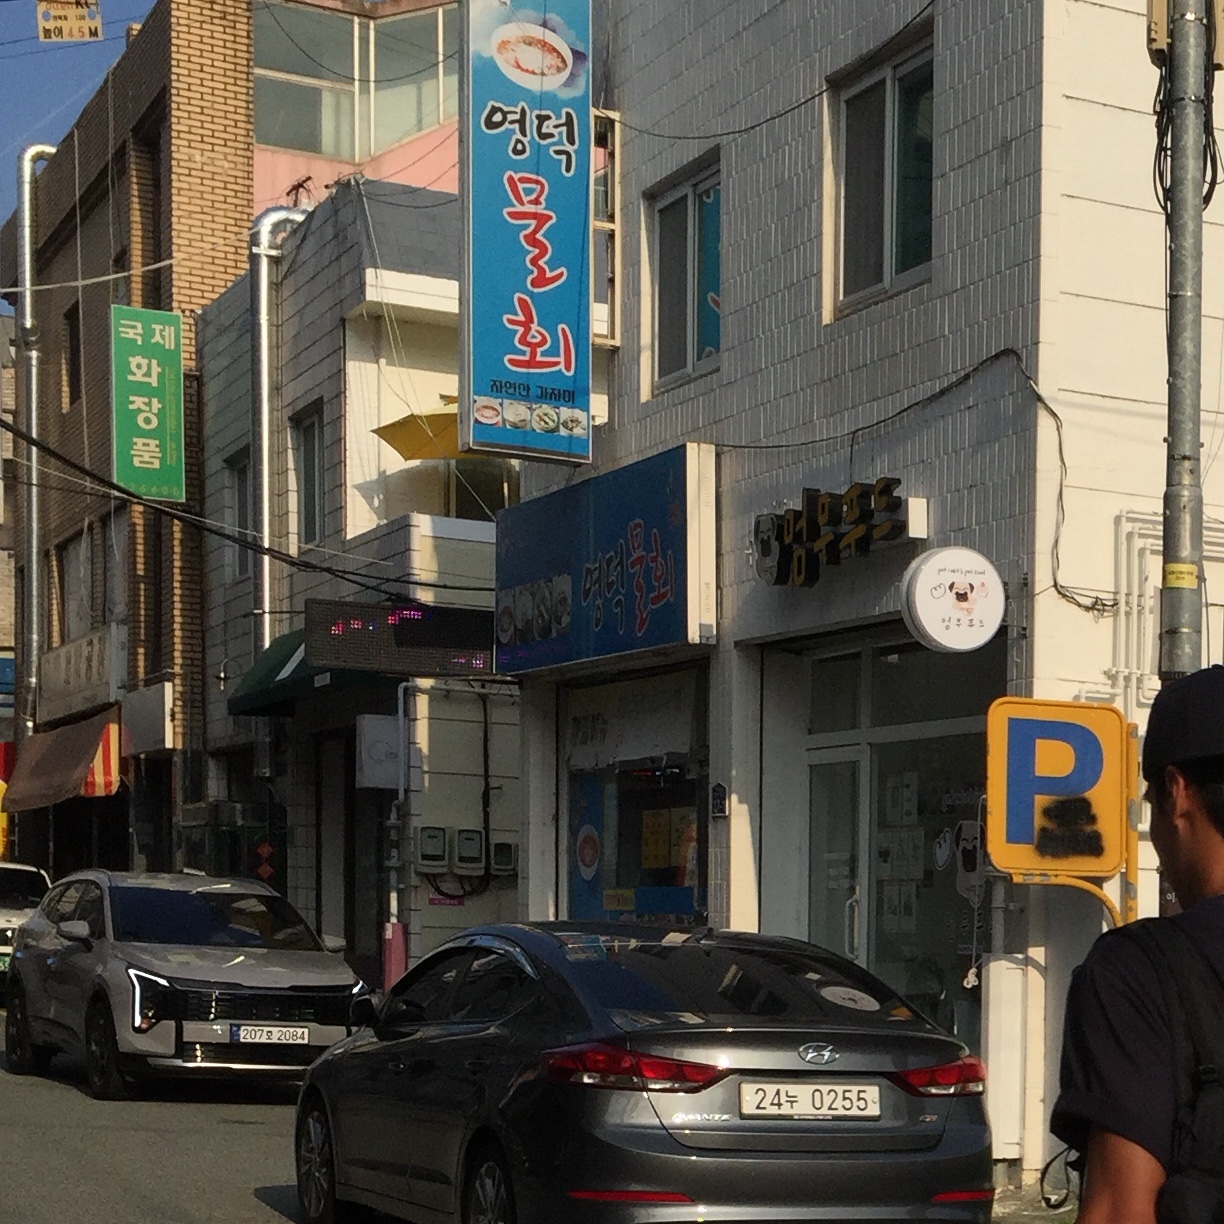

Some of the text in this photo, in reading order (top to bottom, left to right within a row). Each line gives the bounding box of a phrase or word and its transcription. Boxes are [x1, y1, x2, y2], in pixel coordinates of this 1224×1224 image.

[483, 101, 577, 175] 영덕
[503, 171, 575, 374] 물회
[118, 319, 176, 350] 국제
[127, 355, 163, 469] 화장품
[1006, 717, 1104, 844] P
[276, 1030, 306, 1042] 2084
[754, 1087, 868, 1112] 24누 0255
